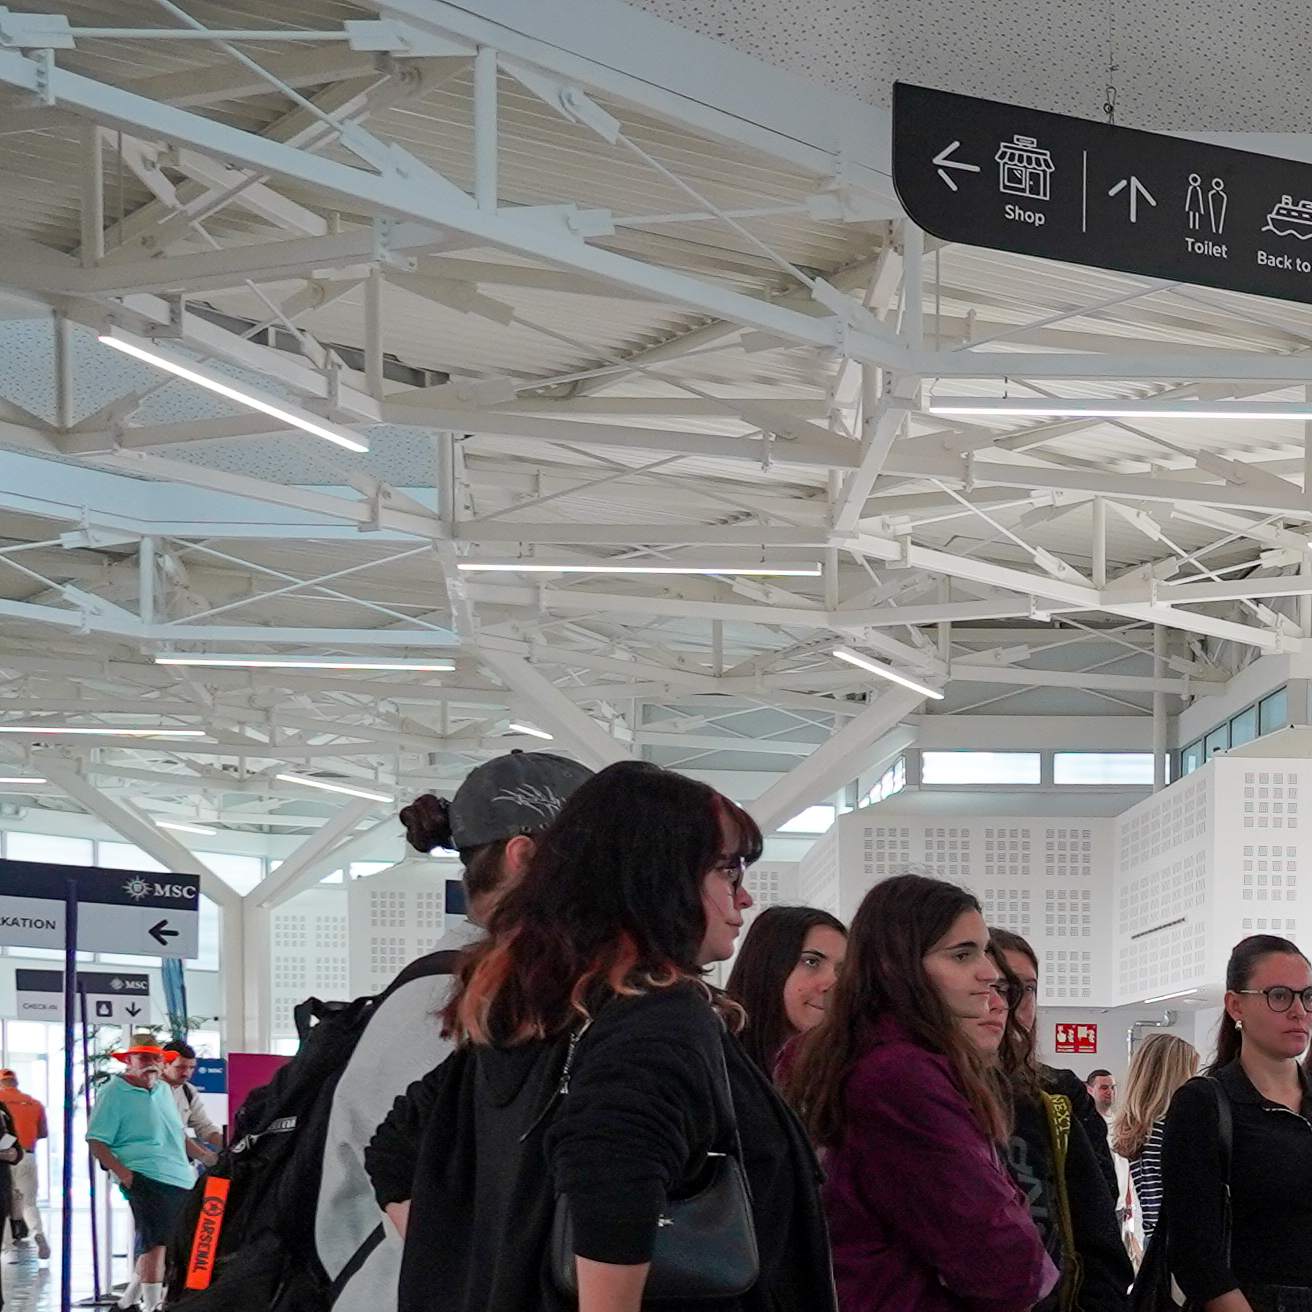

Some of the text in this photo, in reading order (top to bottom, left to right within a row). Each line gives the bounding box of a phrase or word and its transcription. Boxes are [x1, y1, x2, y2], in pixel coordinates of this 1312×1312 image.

[1004, 204, 1045, 226] Shop
[1185, 237, 1228, 259] Toilet
[1257, 250, 1292, 270] Back
[1296, 259, 1311, 273] to
[153, 883, 197, 899] MSC
[0, 916, 56, 930] KATION
[193, 1218, 216, 1273] ARSENAL
